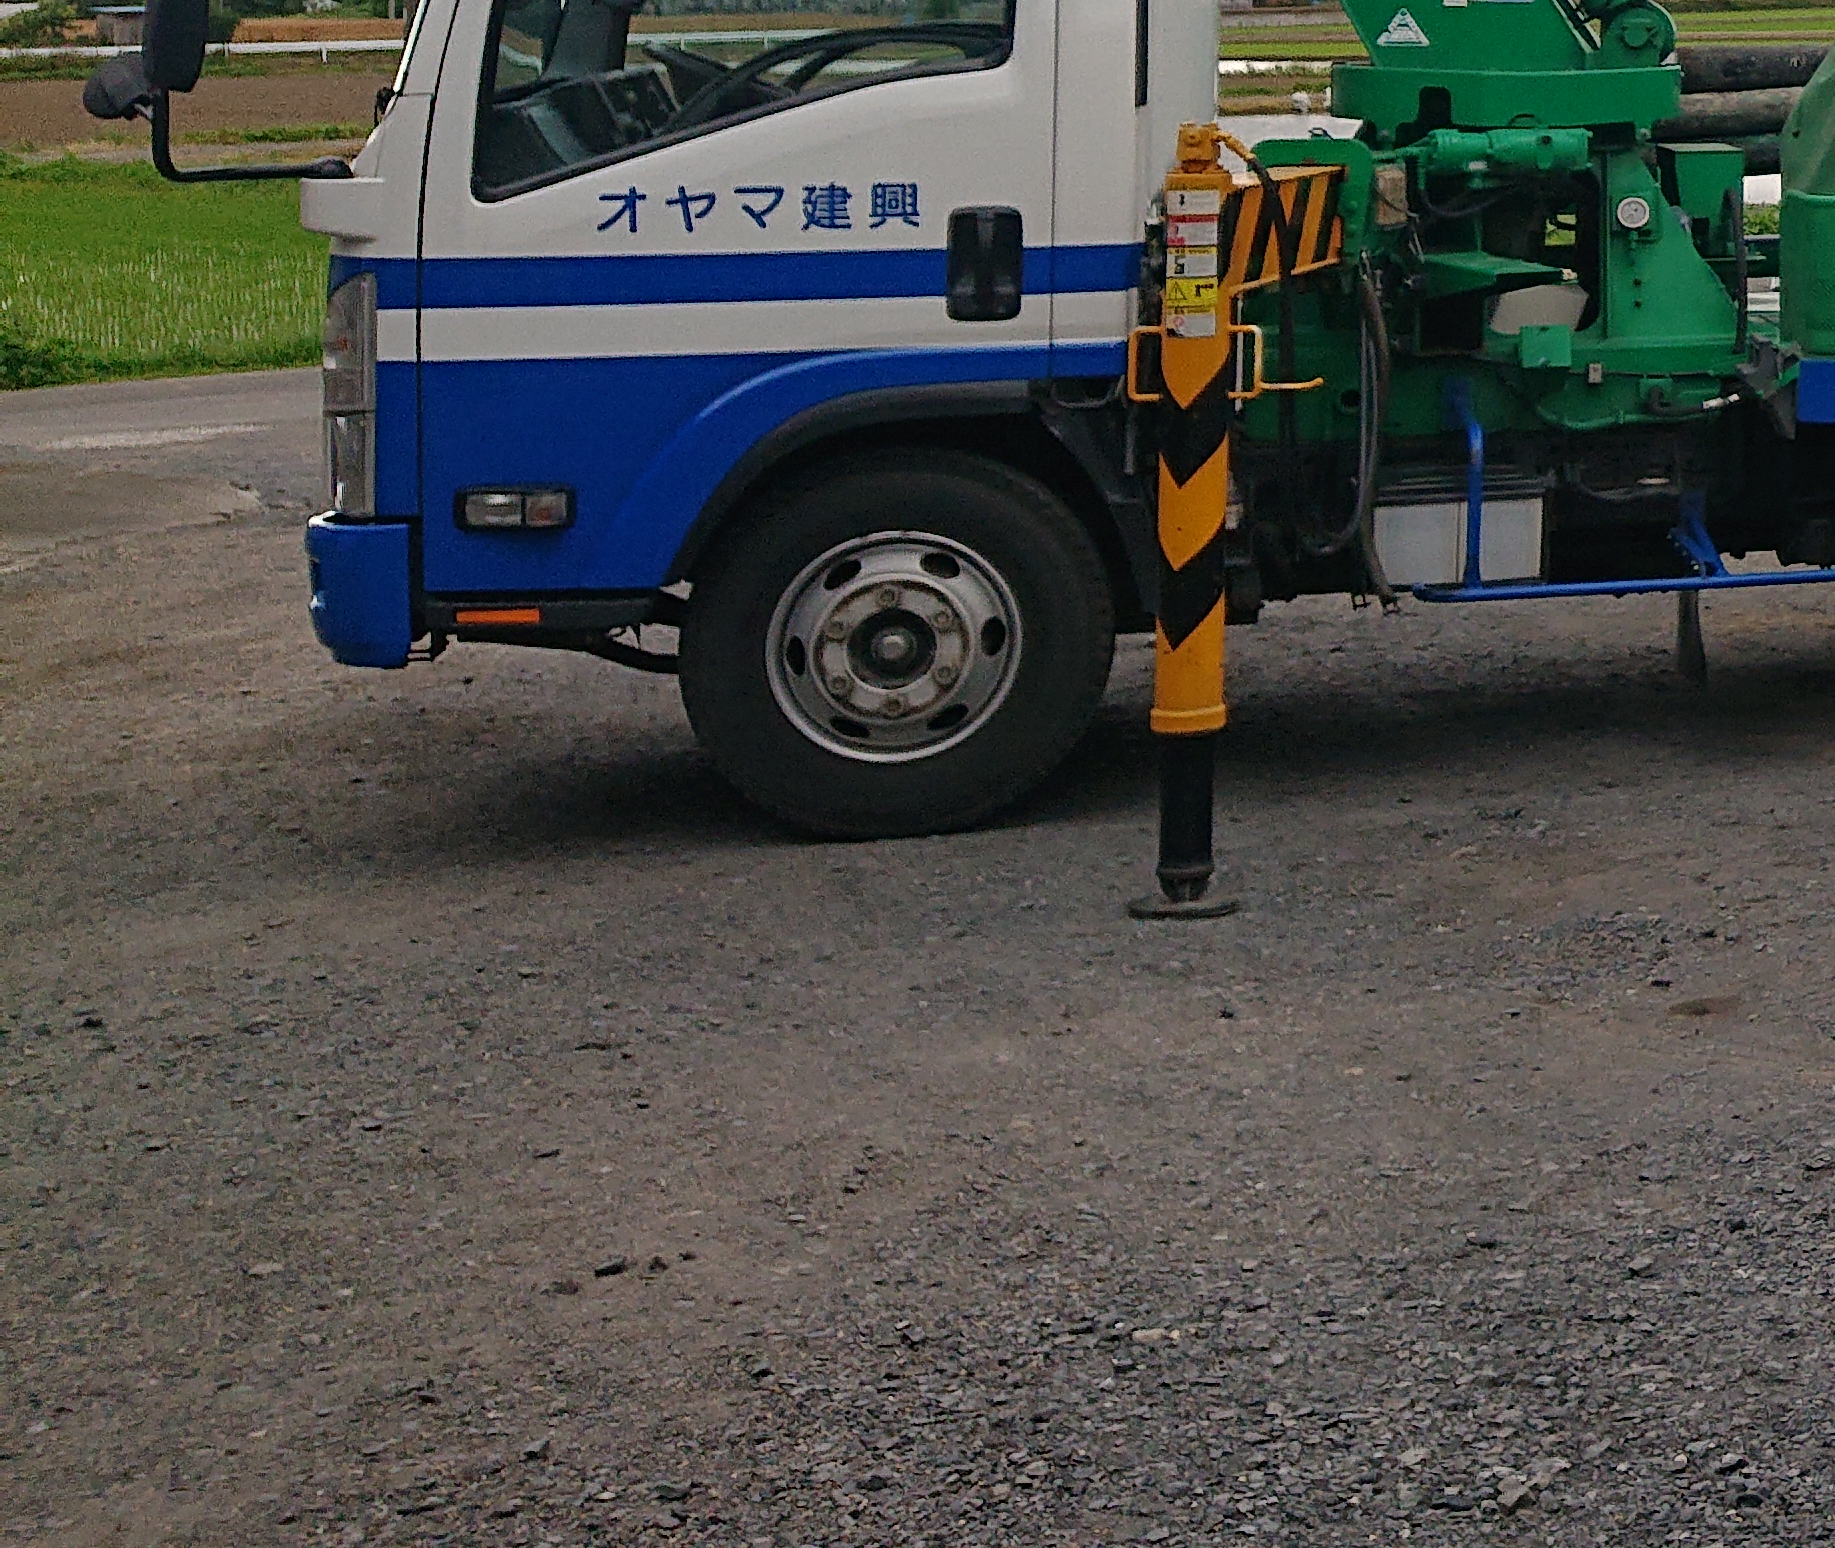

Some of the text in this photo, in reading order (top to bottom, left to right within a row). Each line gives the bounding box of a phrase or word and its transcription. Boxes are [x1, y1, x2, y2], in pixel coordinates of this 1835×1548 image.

[597, 182, 920, 233] オヤマ建興
